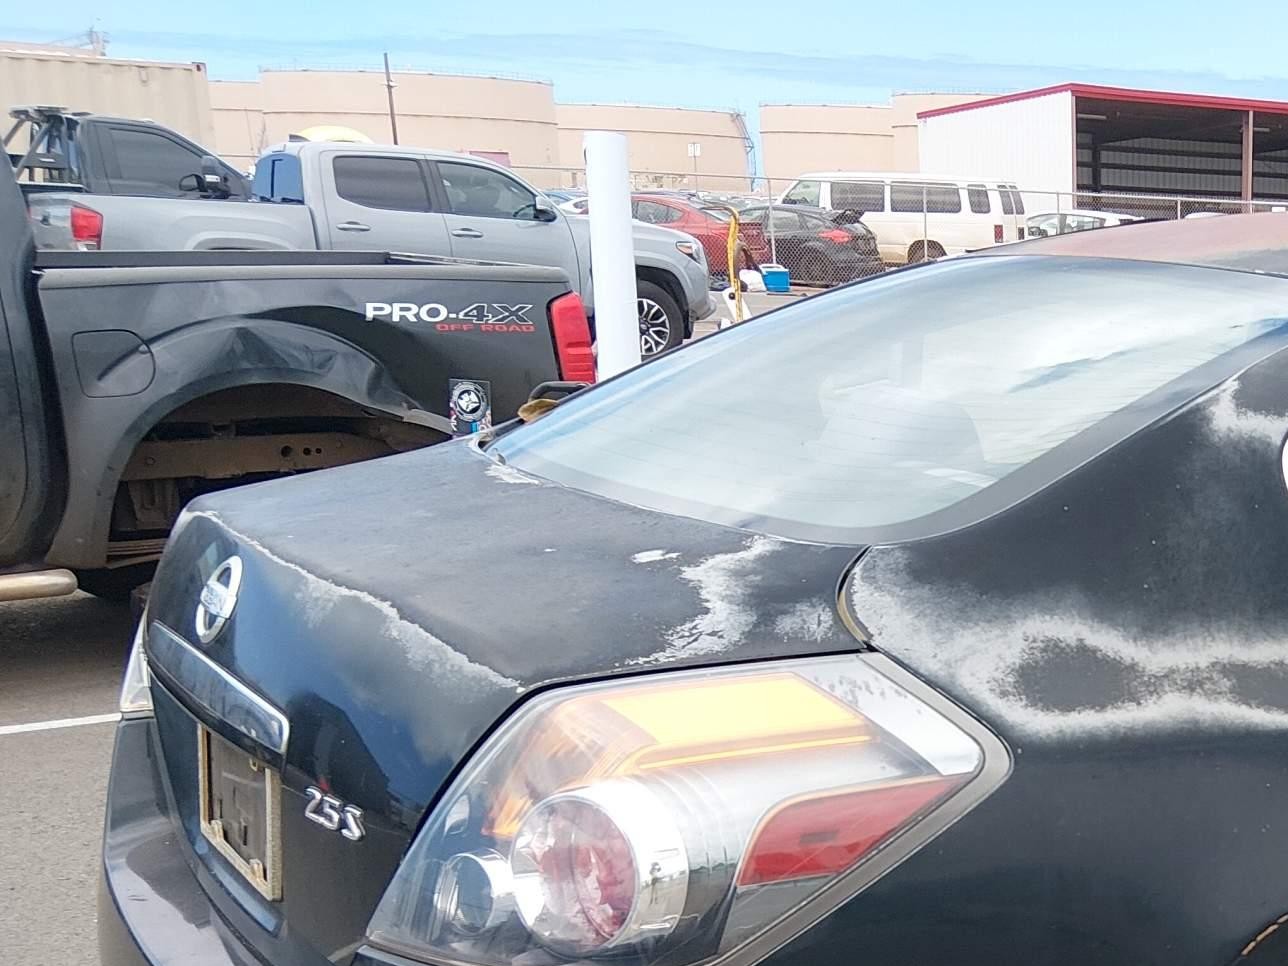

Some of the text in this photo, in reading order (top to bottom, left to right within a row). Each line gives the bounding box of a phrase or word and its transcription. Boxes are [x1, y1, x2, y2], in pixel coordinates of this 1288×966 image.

[365, 303, 534, 325] PRO-4X
[435, 323, 536, 333] OFF ROAD
